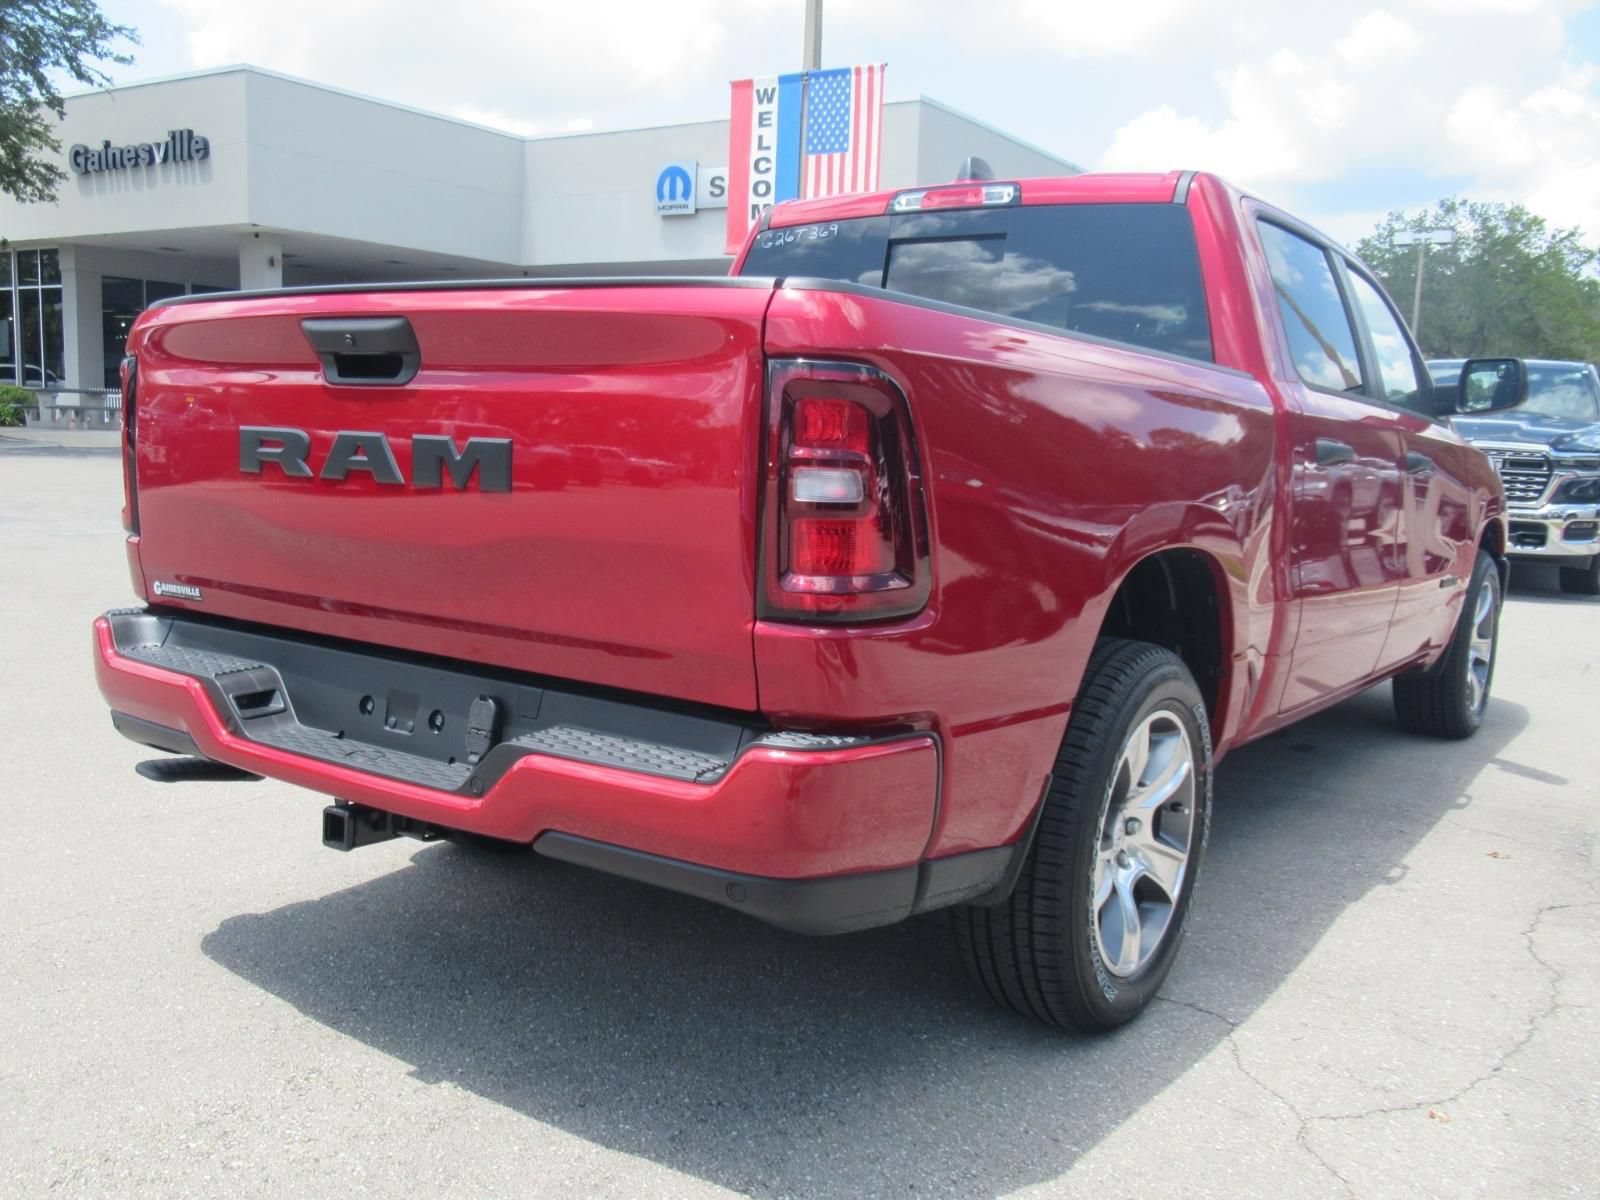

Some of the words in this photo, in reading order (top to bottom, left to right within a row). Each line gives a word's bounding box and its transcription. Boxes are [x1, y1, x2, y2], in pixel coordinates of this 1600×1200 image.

[69, 128, 210, 175] Gainesville
[751, 87, 776, 221] WELCOM
[657, 203, 689, 212] MOPAR
[239, 425, 513, 494] RAM
[153, 581, 201, 596] GAINESVILLE
